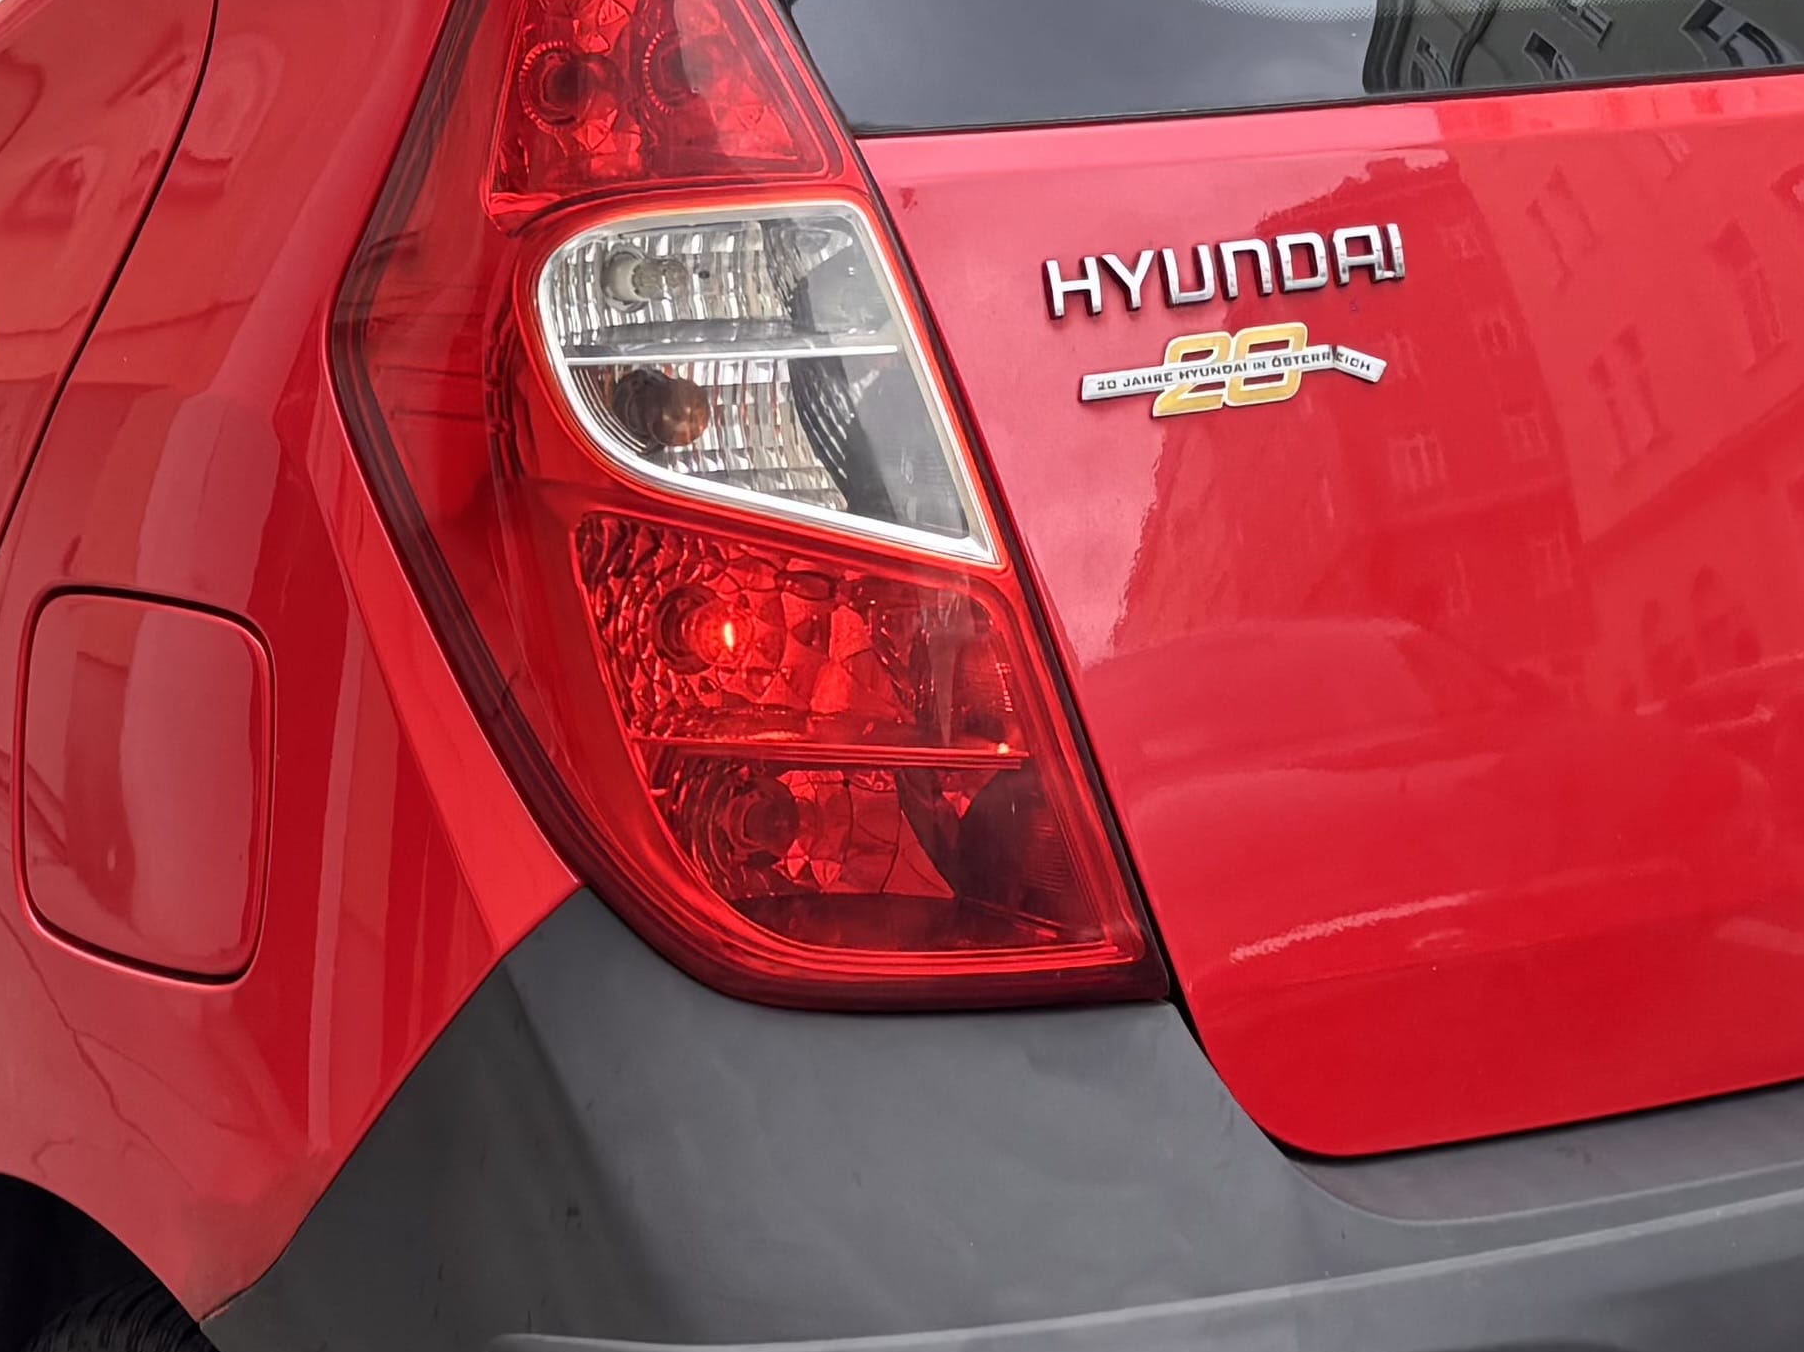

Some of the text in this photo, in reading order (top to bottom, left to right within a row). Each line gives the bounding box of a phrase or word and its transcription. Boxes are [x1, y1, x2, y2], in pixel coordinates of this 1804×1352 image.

[1043, 223, 1406, 320] HYUNDAI
[1122, 371, 1174, 388] JAHRE
[1179, 361, 1248, 381] HYUNDAI
[1252, 359, 1267, 371] IN
